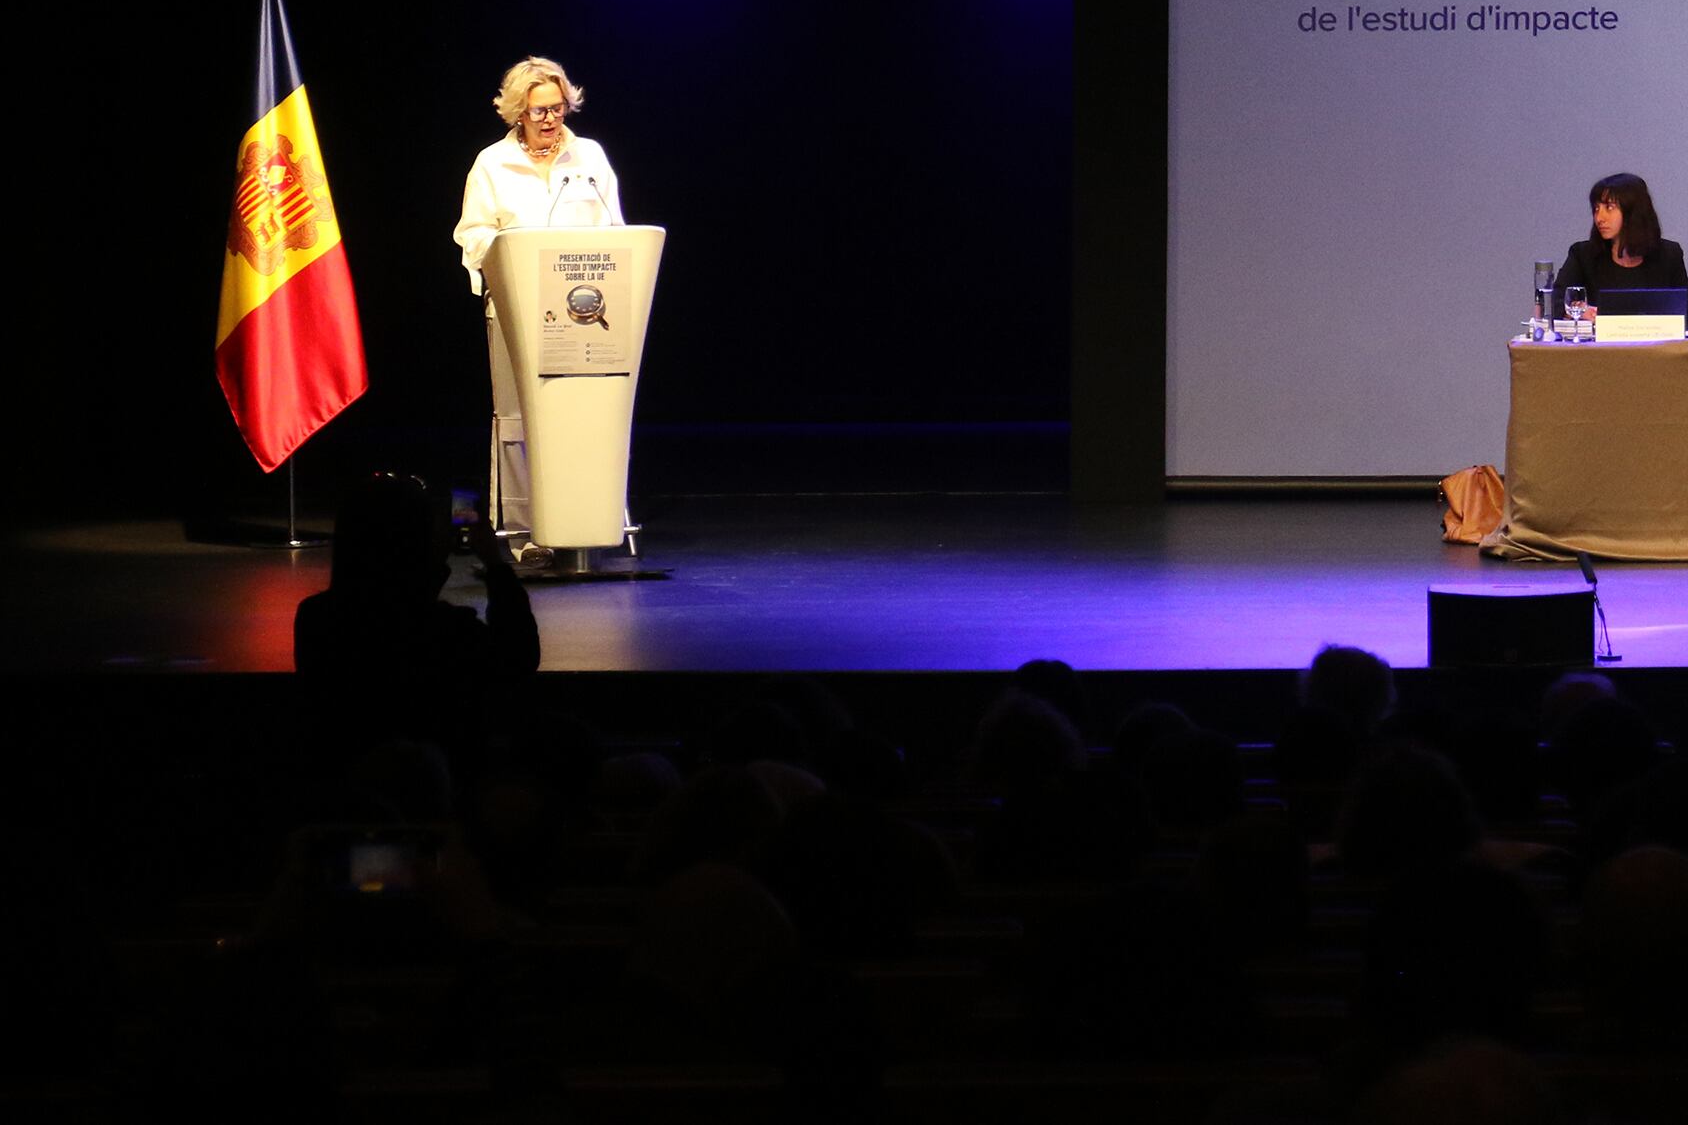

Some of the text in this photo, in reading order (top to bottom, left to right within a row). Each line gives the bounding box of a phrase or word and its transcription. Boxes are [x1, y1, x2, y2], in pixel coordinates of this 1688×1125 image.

[1297, 4, 1619, 37] de l'estudi d'impacte
[559, 252, 611, 262] PRESENTACIÓ DE
[553, 262, 617, 272] L'ESTUDI D'IMPACTE
[565, 272, 605, 281] SOBRE LA UE
